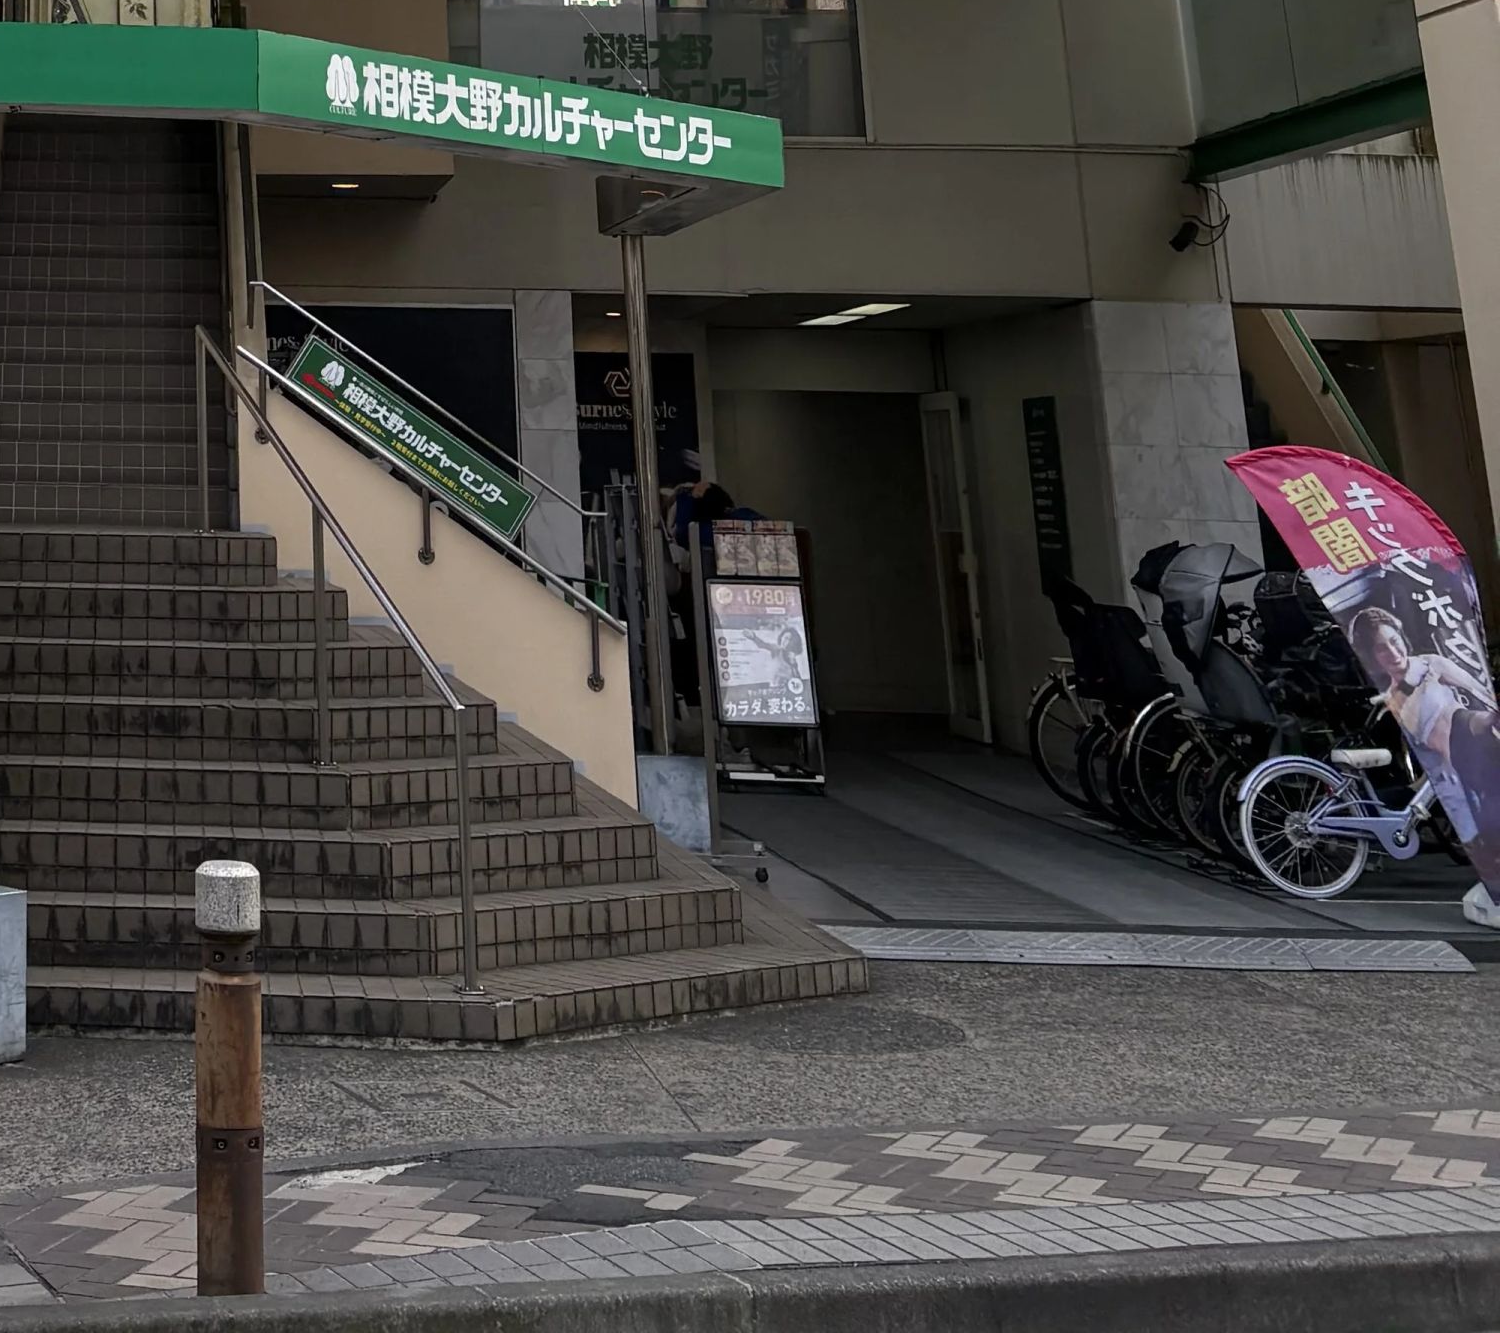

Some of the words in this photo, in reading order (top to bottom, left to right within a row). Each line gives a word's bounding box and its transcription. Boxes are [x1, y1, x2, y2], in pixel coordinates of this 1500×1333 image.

[362, 61, 733, 167] 相模大野カルチャーセンター
[342, 382, 508, 506] 相模大野カルチャーセンター
[576, 404, 633, 420] urnes
